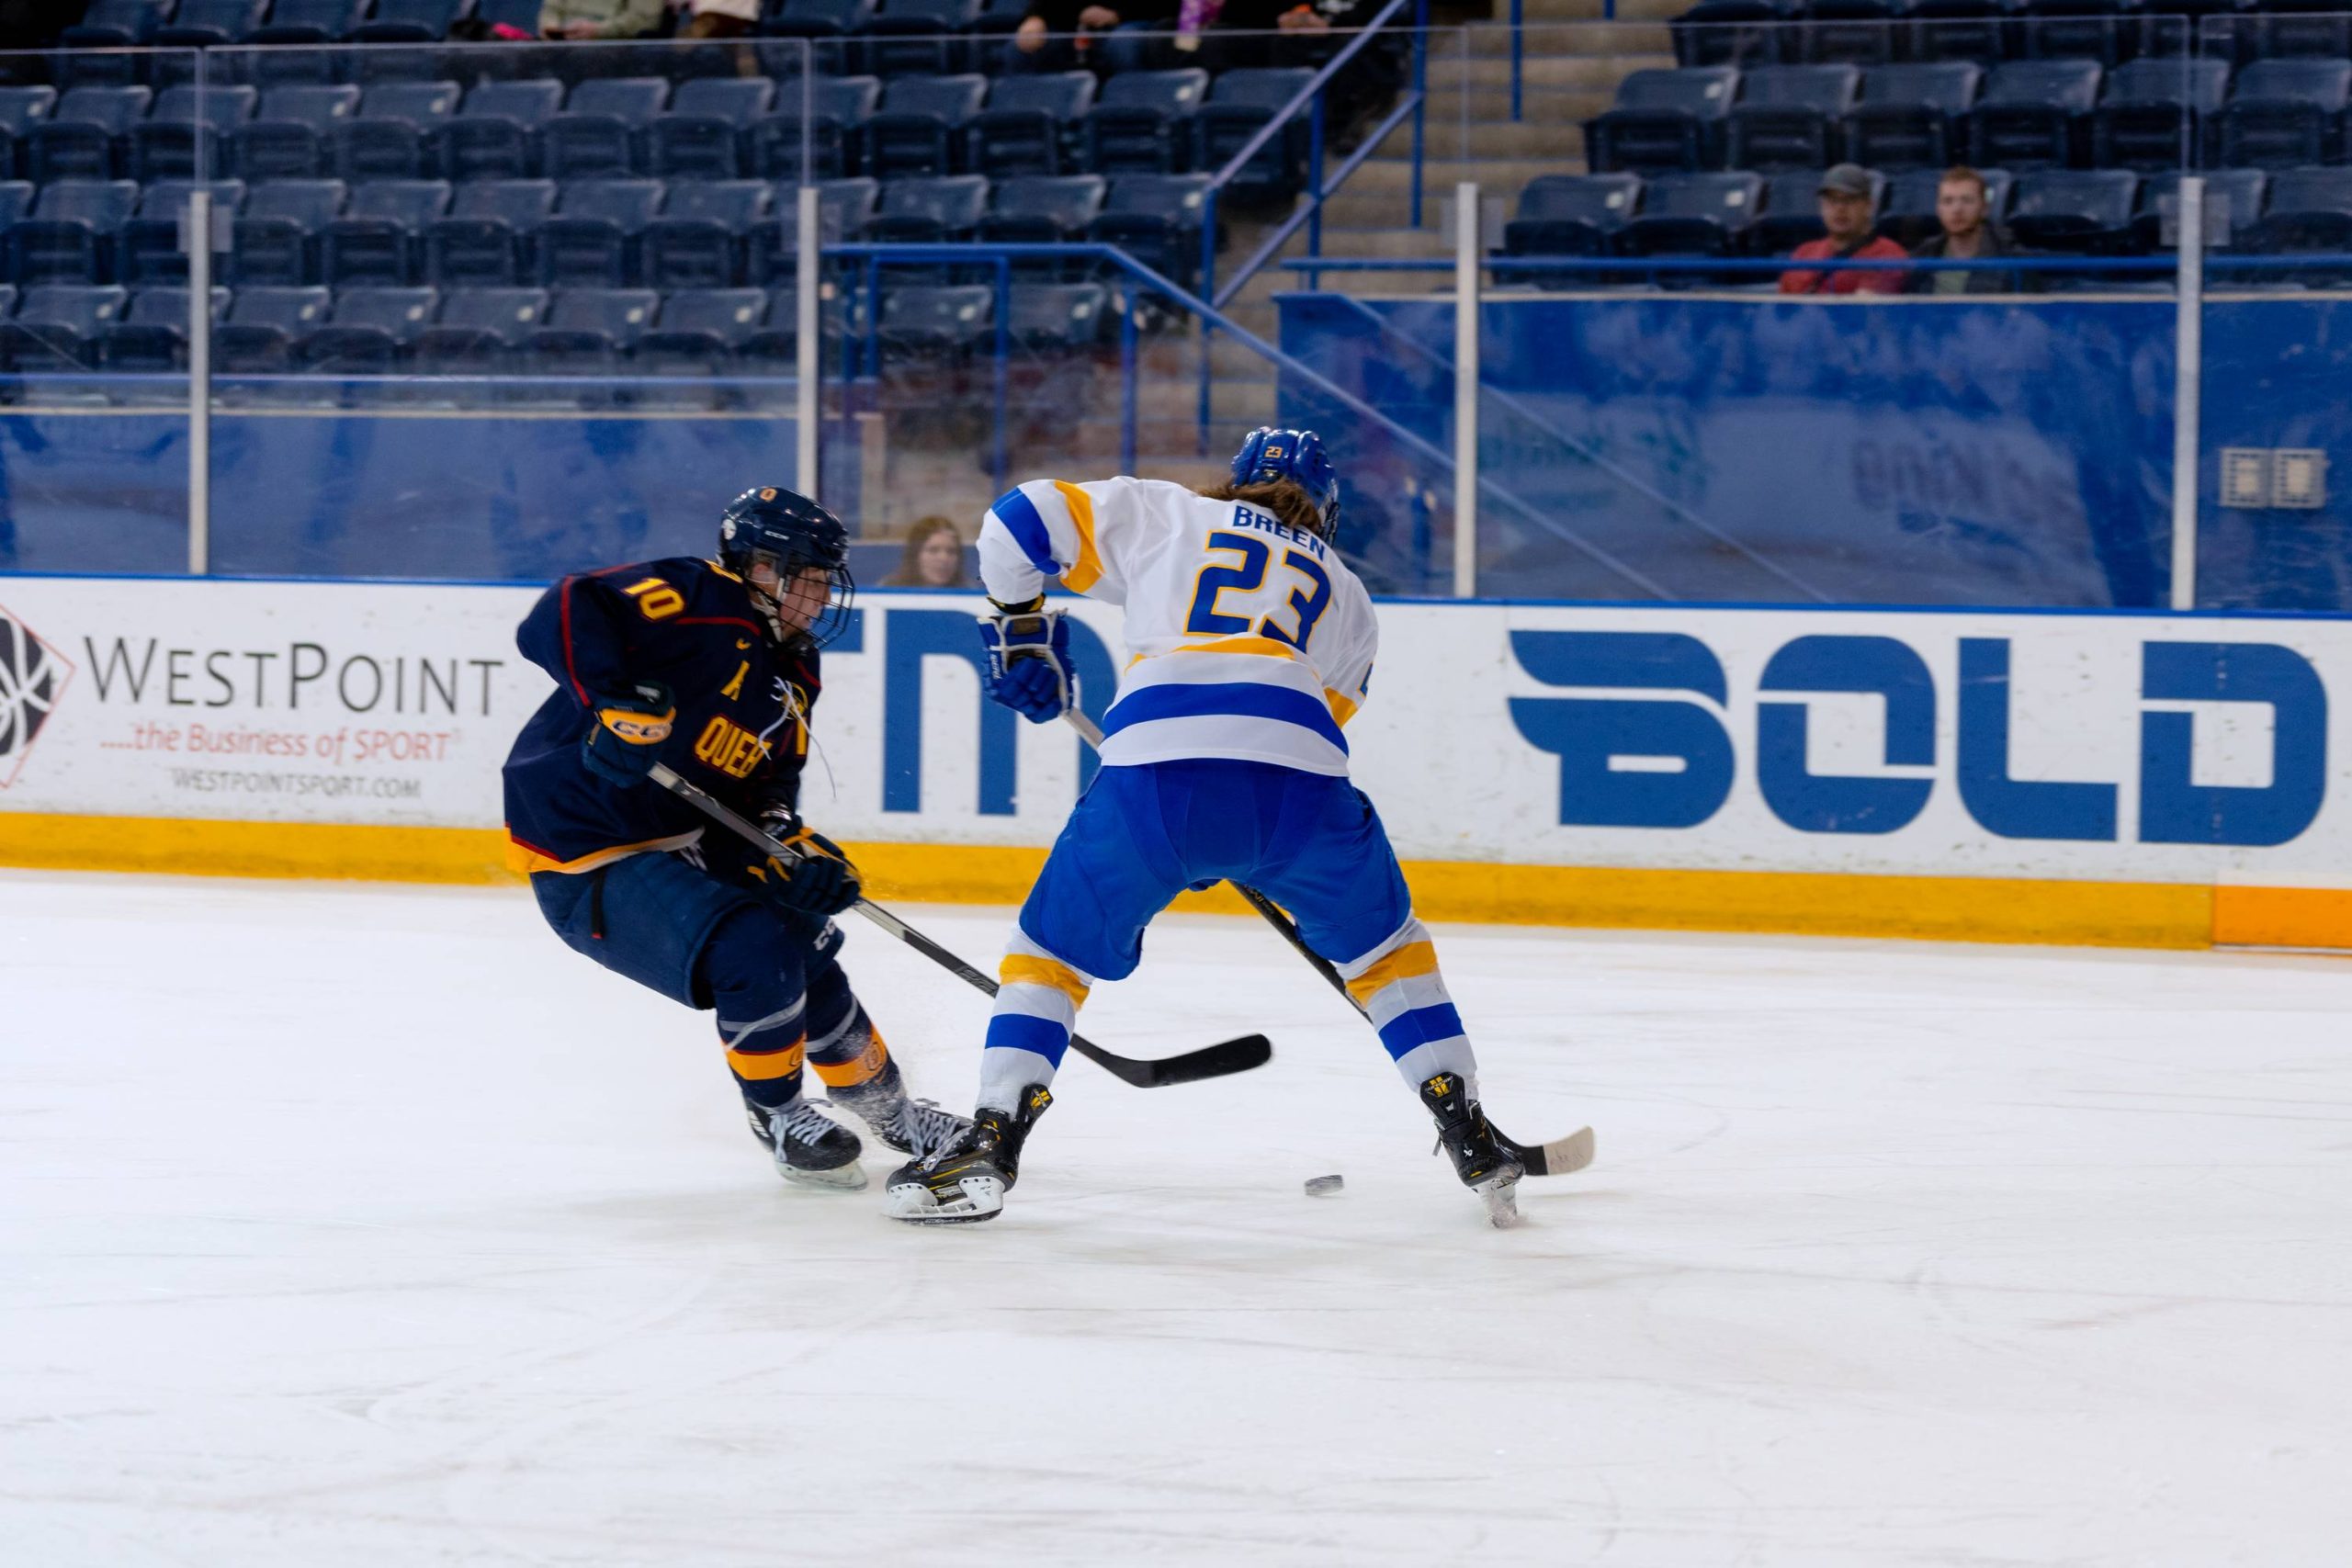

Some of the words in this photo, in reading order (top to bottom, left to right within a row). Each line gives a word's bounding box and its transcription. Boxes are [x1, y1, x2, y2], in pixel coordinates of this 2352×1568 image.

[1264, 446, 1283, 458] 23
[1233, 505, 1325, 562] BREEN
[620, 577, 684, 621] 10
[1182, 528, 1332, 655] 23
[187, 722, 308, 757] Business
[315, 728, 350, 765] of
[354, 729, 451, 761] SPORT
[1508, 629, 2328, 847] BOLD
[171, 766, 422, 798] WESTPOINTSPORT.COM
